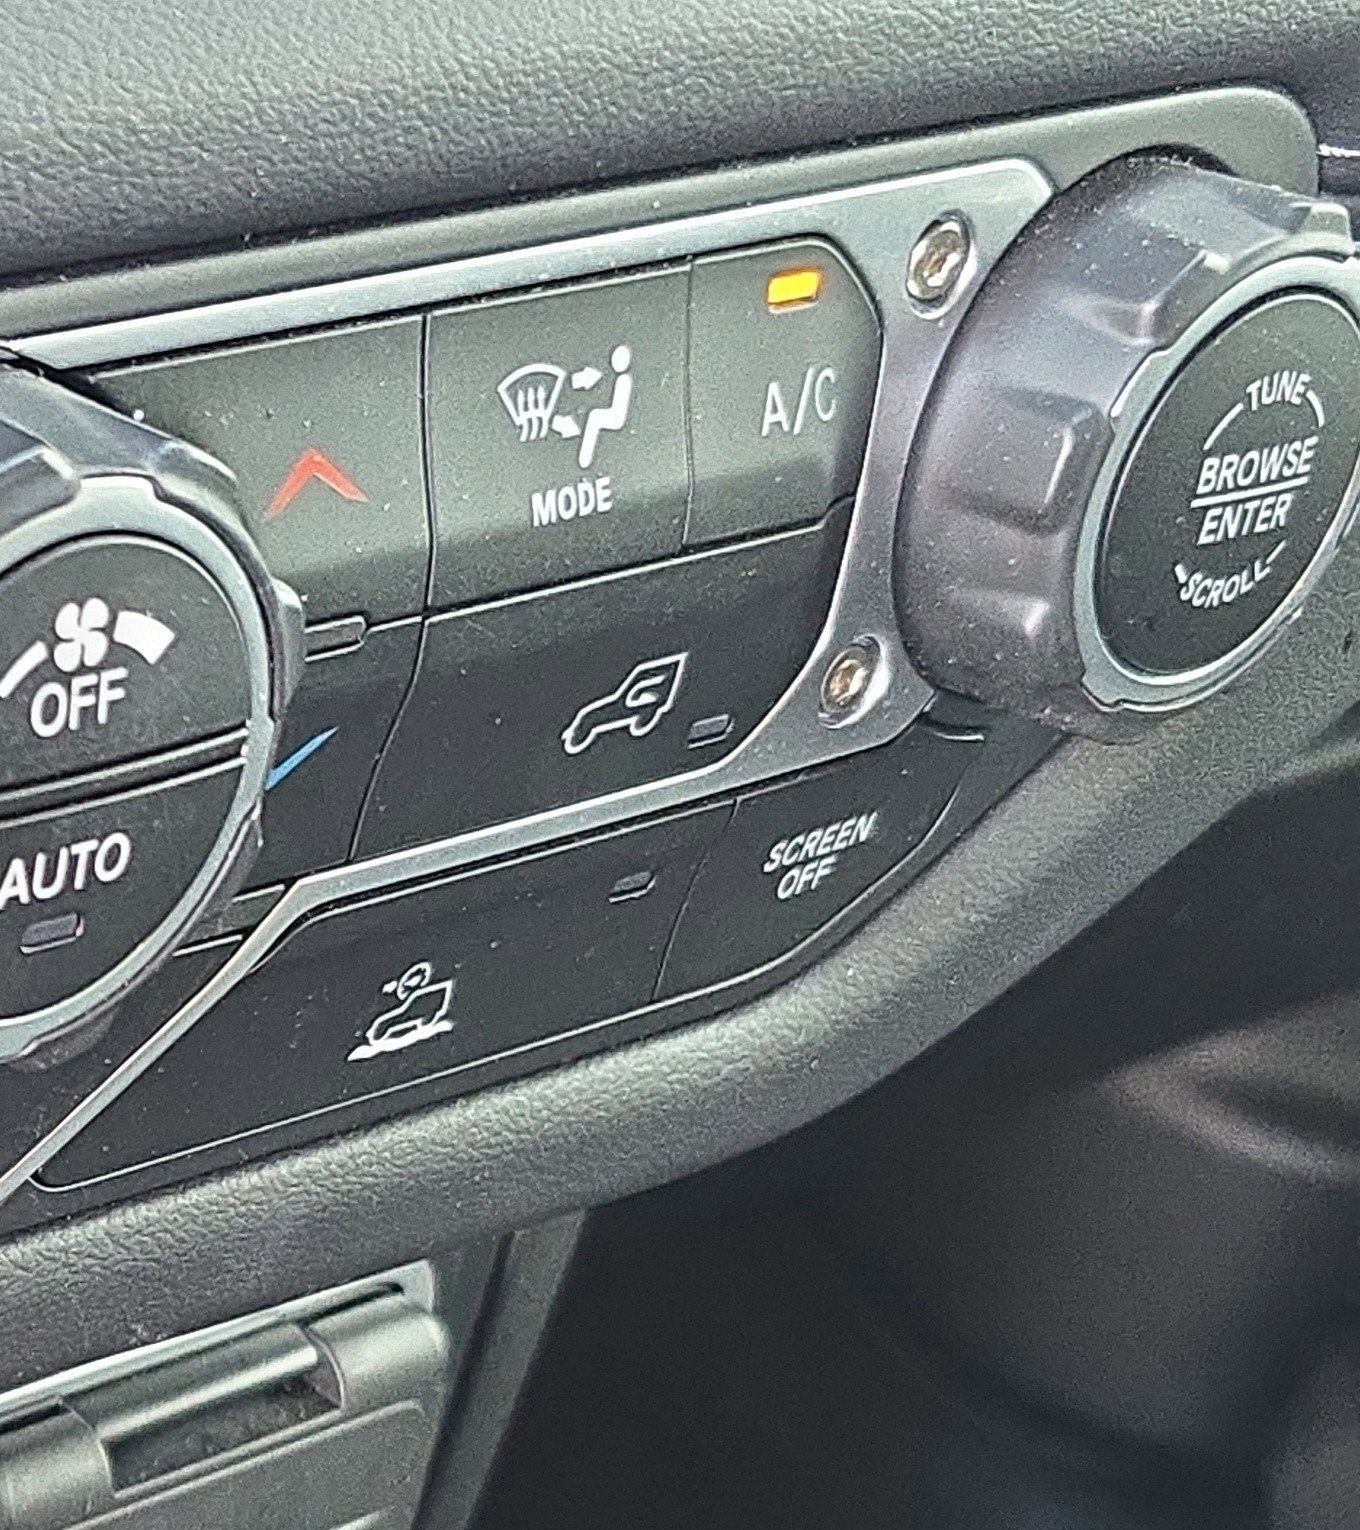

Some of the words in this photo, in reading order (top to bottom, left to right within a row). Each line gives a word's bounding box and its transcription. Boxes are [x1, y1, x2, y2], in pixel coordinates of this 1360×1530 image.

[761, 366, 837, 437] A/C
[1245, 370, 1312, 411] TUNE
[1196, 435, 1319, 495] BROWSE
[531, 475, 613, 527] MODE
[1197, 492, 1295, 546] ENTER
[1179, 558, 1273, 609] SCROLL
[29, 666, 129, 738] OFF
[763, 811, 879, 872] SCREEN
[776, 855, 837, 900] OFF
